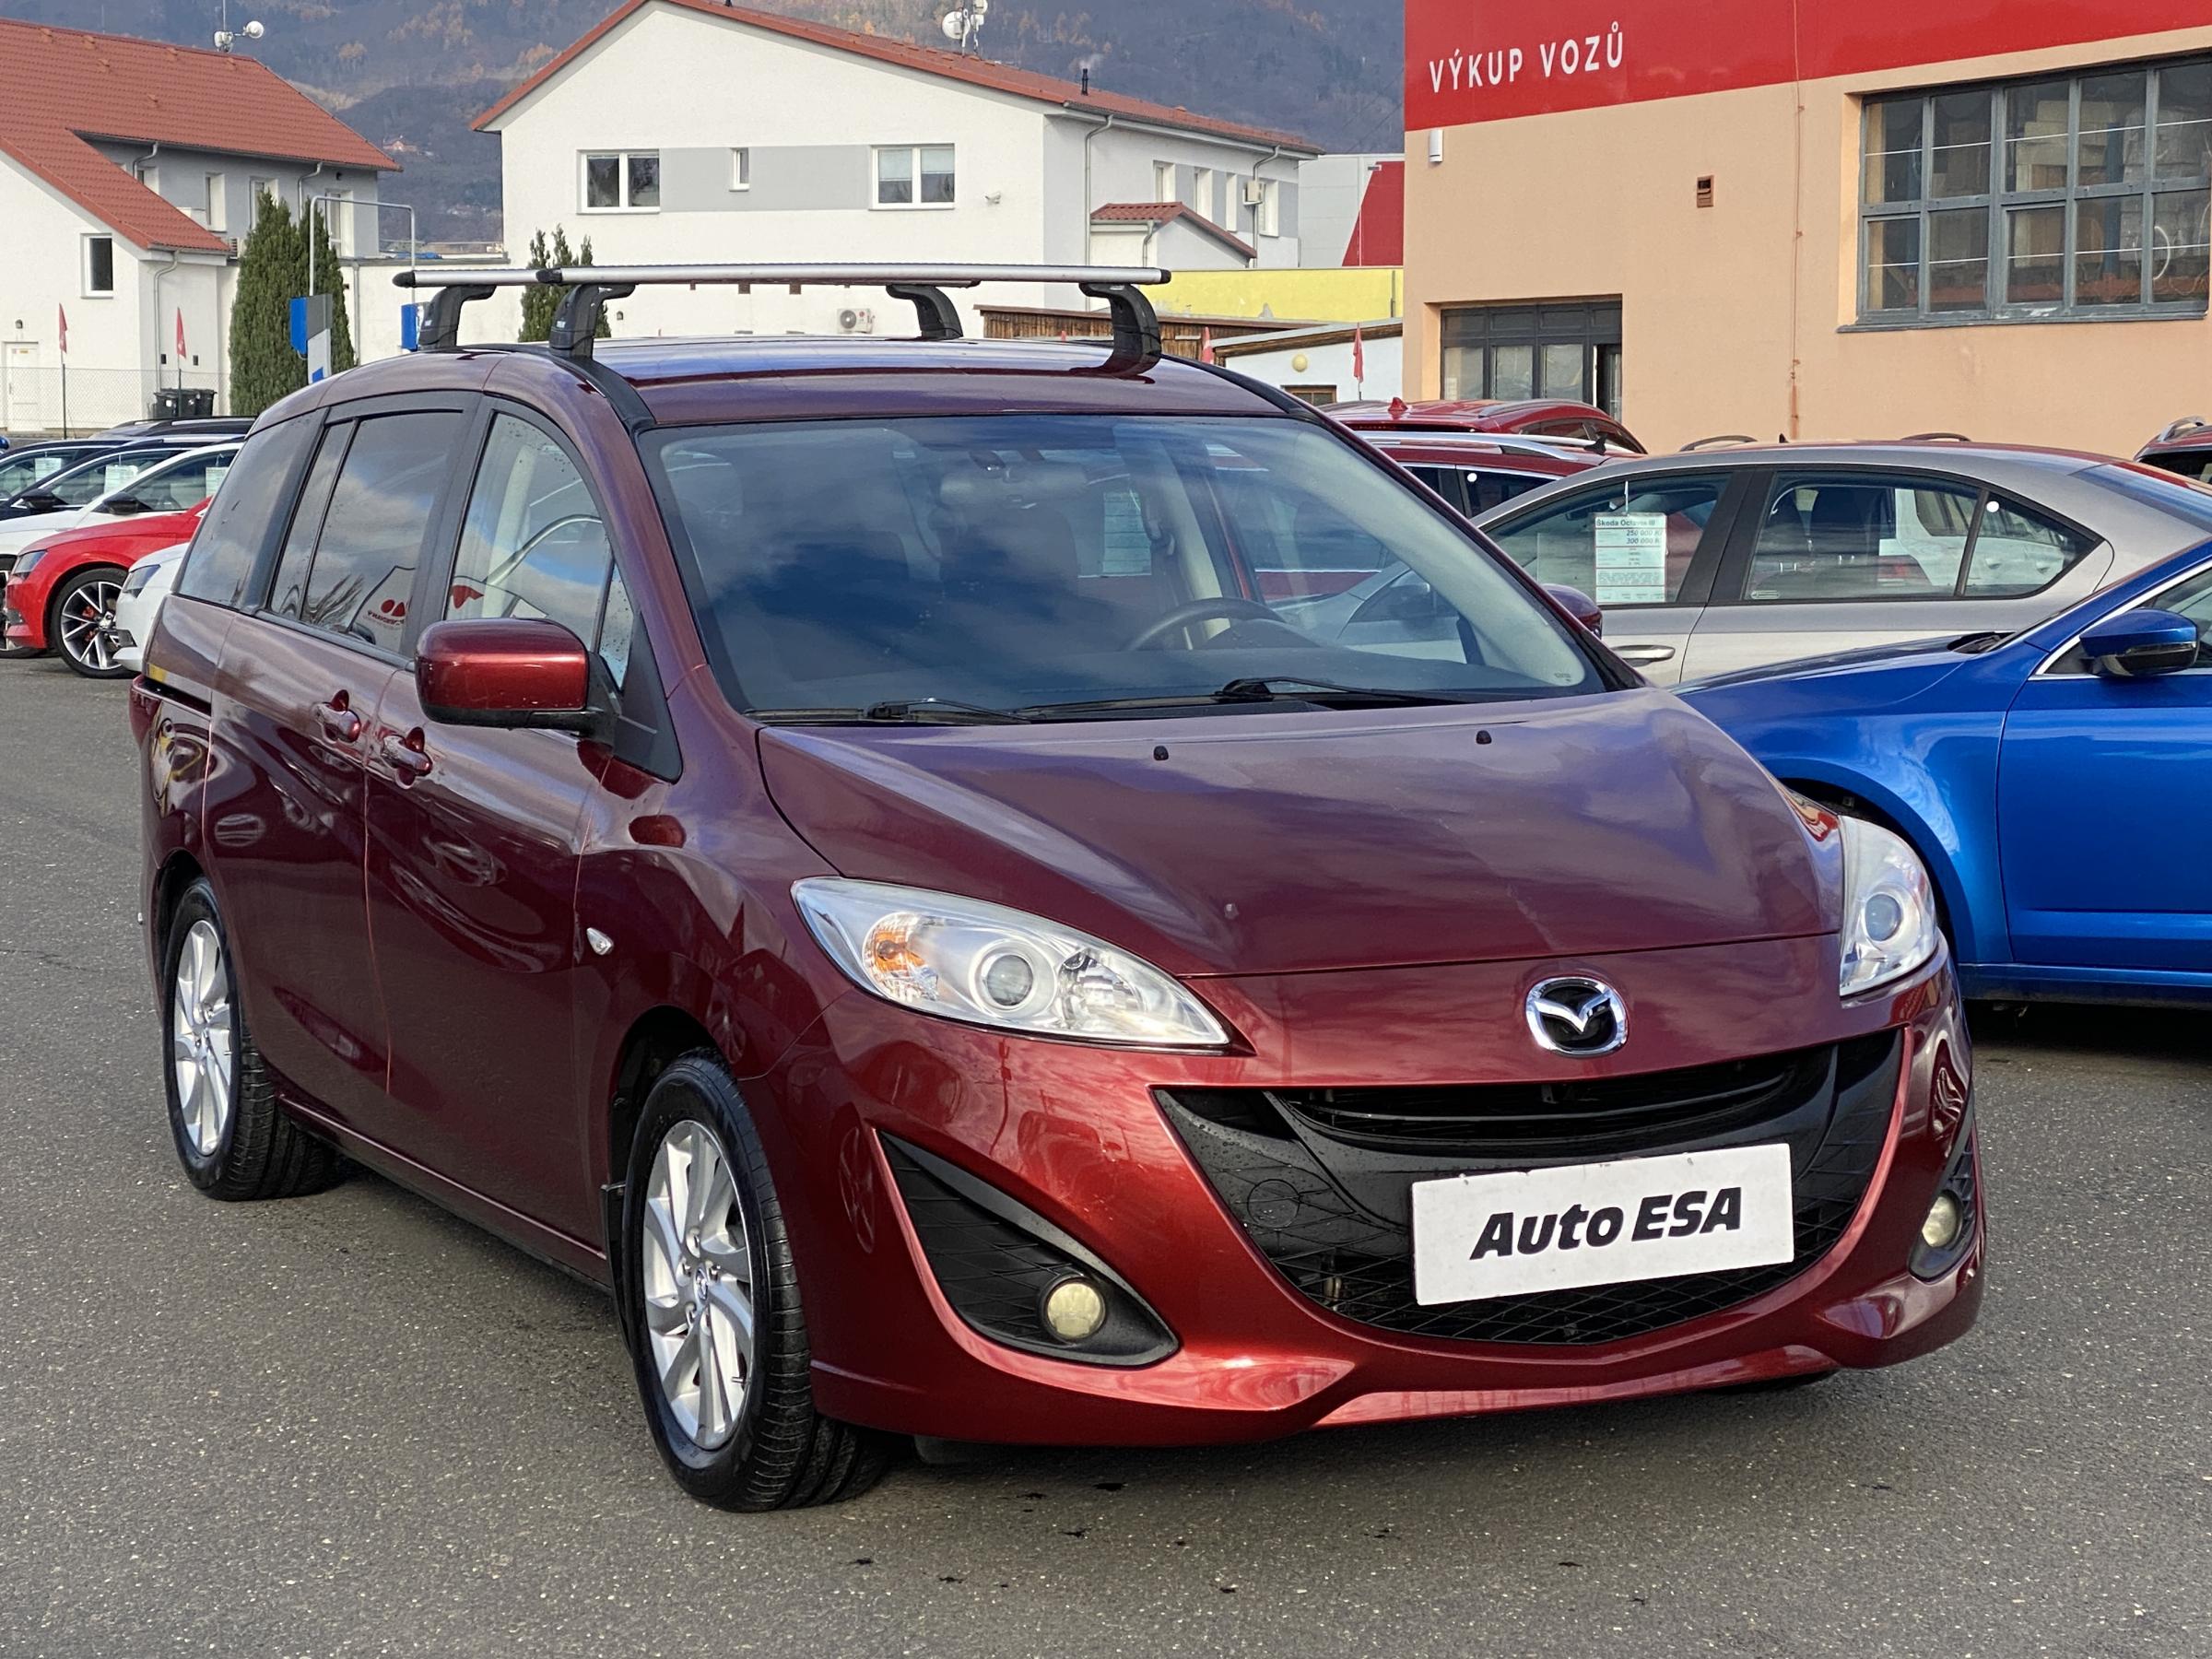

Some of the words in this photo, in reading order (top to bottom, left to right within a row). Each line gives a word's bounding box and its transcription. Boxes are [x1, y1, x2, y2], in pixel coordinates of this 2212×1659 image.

[1430, 48, 1523, 93] VÝKUP
[1540, 20, 1623, 77] VOZŮ
[1596, 518, 1619, 526] Škoda
[1469, 1204, 1624, 1261] Auto
[1630, 1186, 1741, 1241] ESA
